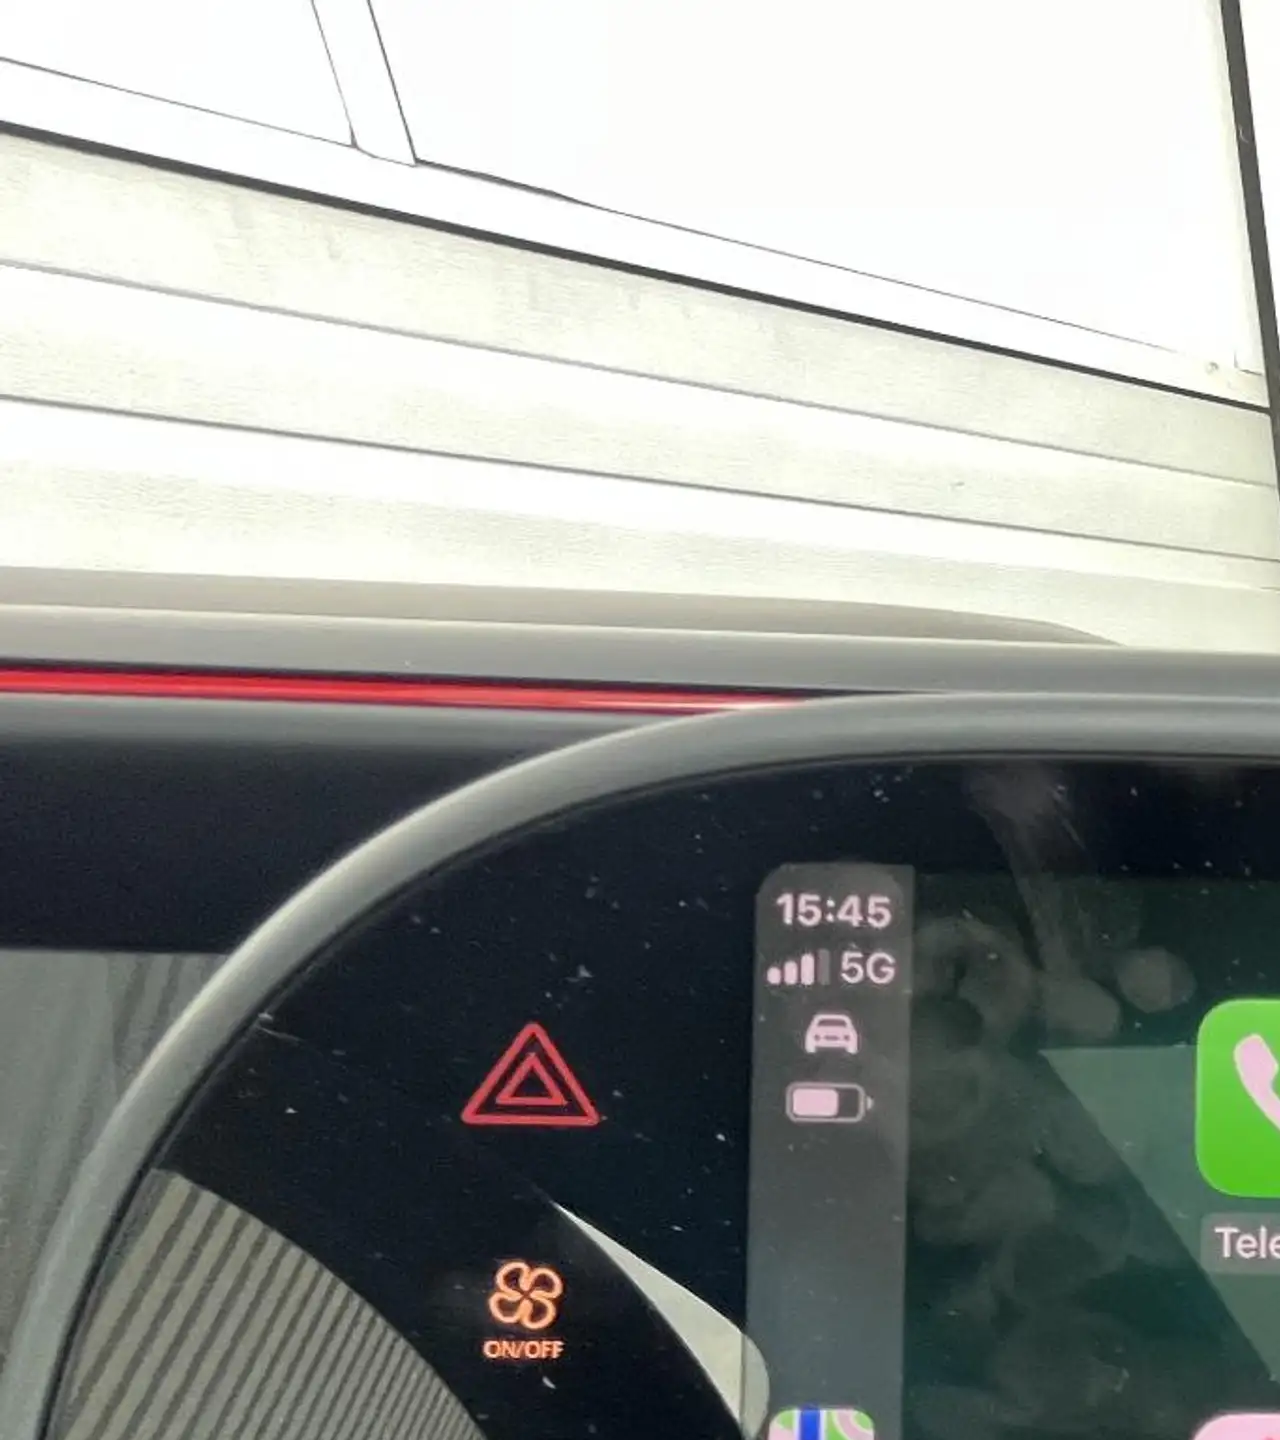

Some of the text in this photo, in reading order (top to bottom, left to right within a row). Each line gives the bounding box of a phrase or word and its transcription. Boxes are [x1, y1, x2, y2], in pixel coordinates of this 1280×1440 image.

[776, 894, 892, 928] 15:45
[841, 953, 896, 986] 5G
[483, 1340, 565, 1361] ON/OFF
